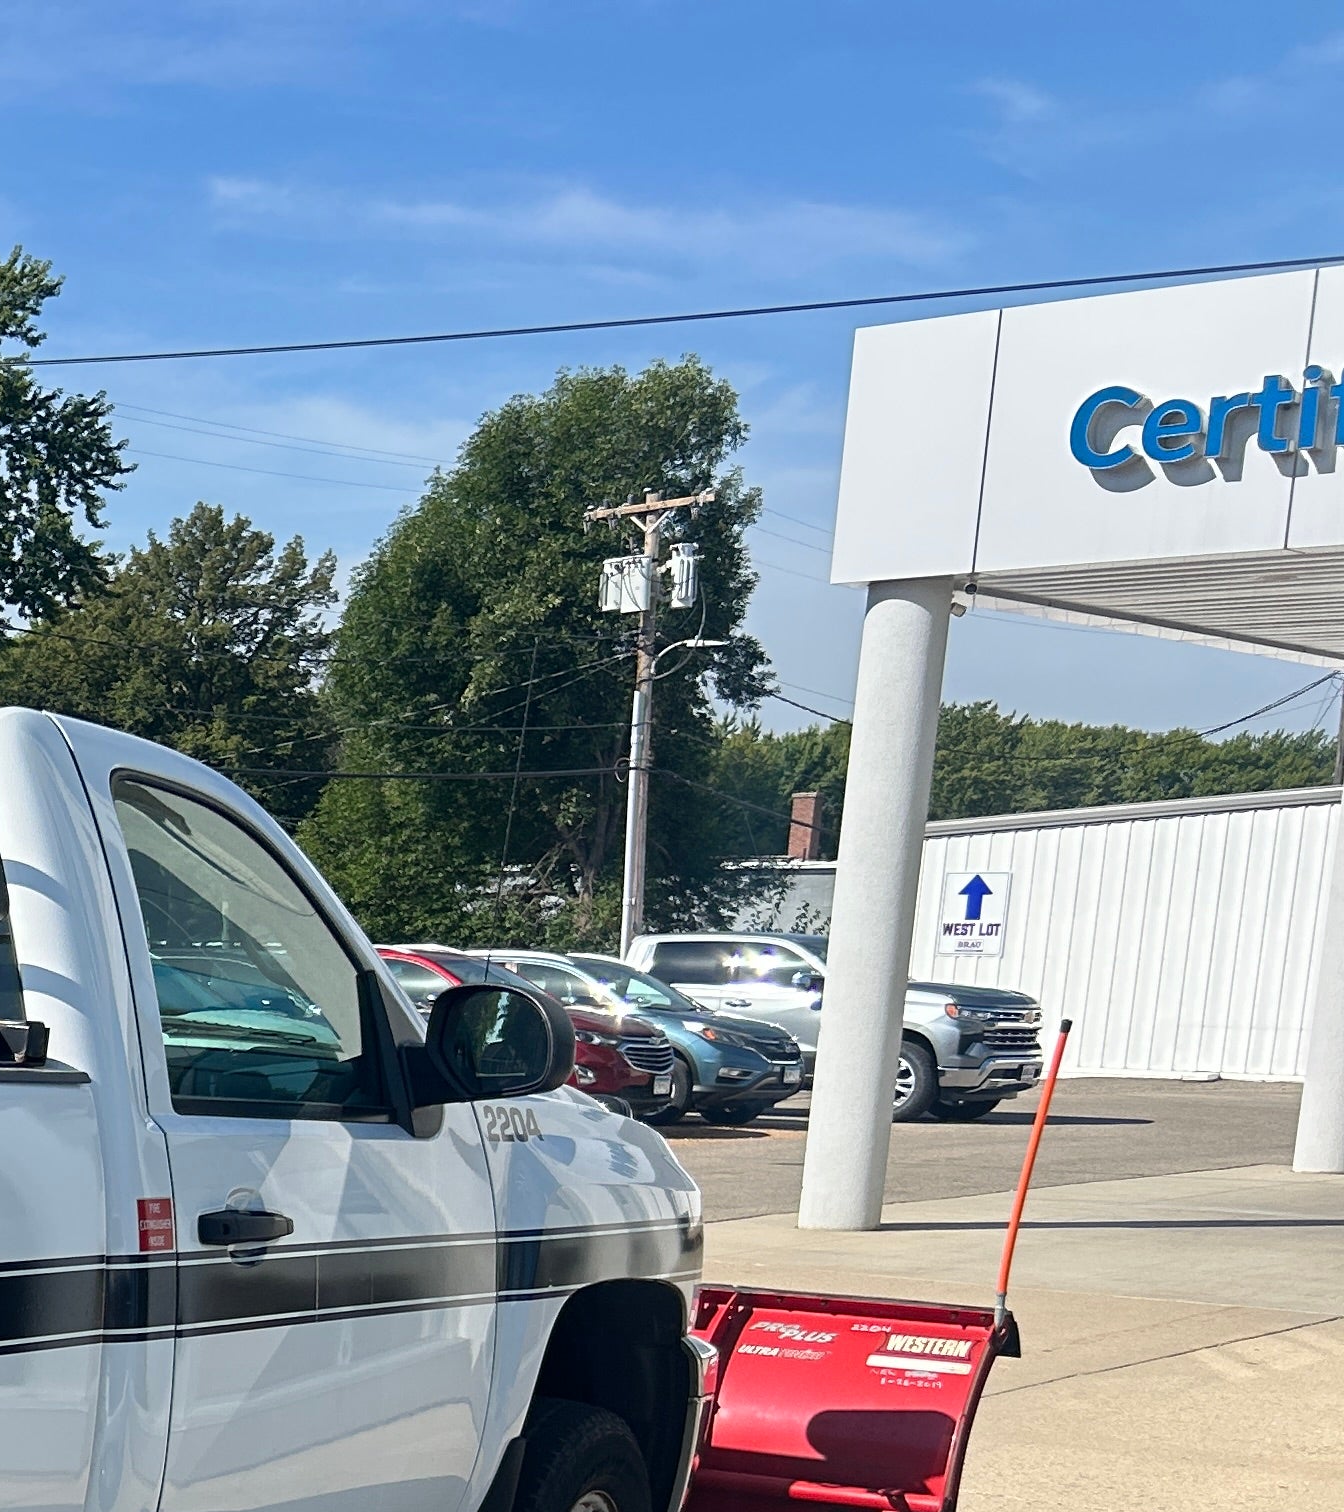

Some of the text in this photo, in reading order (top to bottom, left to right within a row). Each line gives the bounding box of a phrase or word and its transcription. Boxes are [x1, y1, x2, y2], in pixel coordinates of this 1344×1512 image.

[943, 923, 1001, 936] WEST LOT
[483, 1105, 544, 1142] 2204
[778, 1329, 840, 1344] PLUS
[886, 1334, 972, 1358] WESTERN
